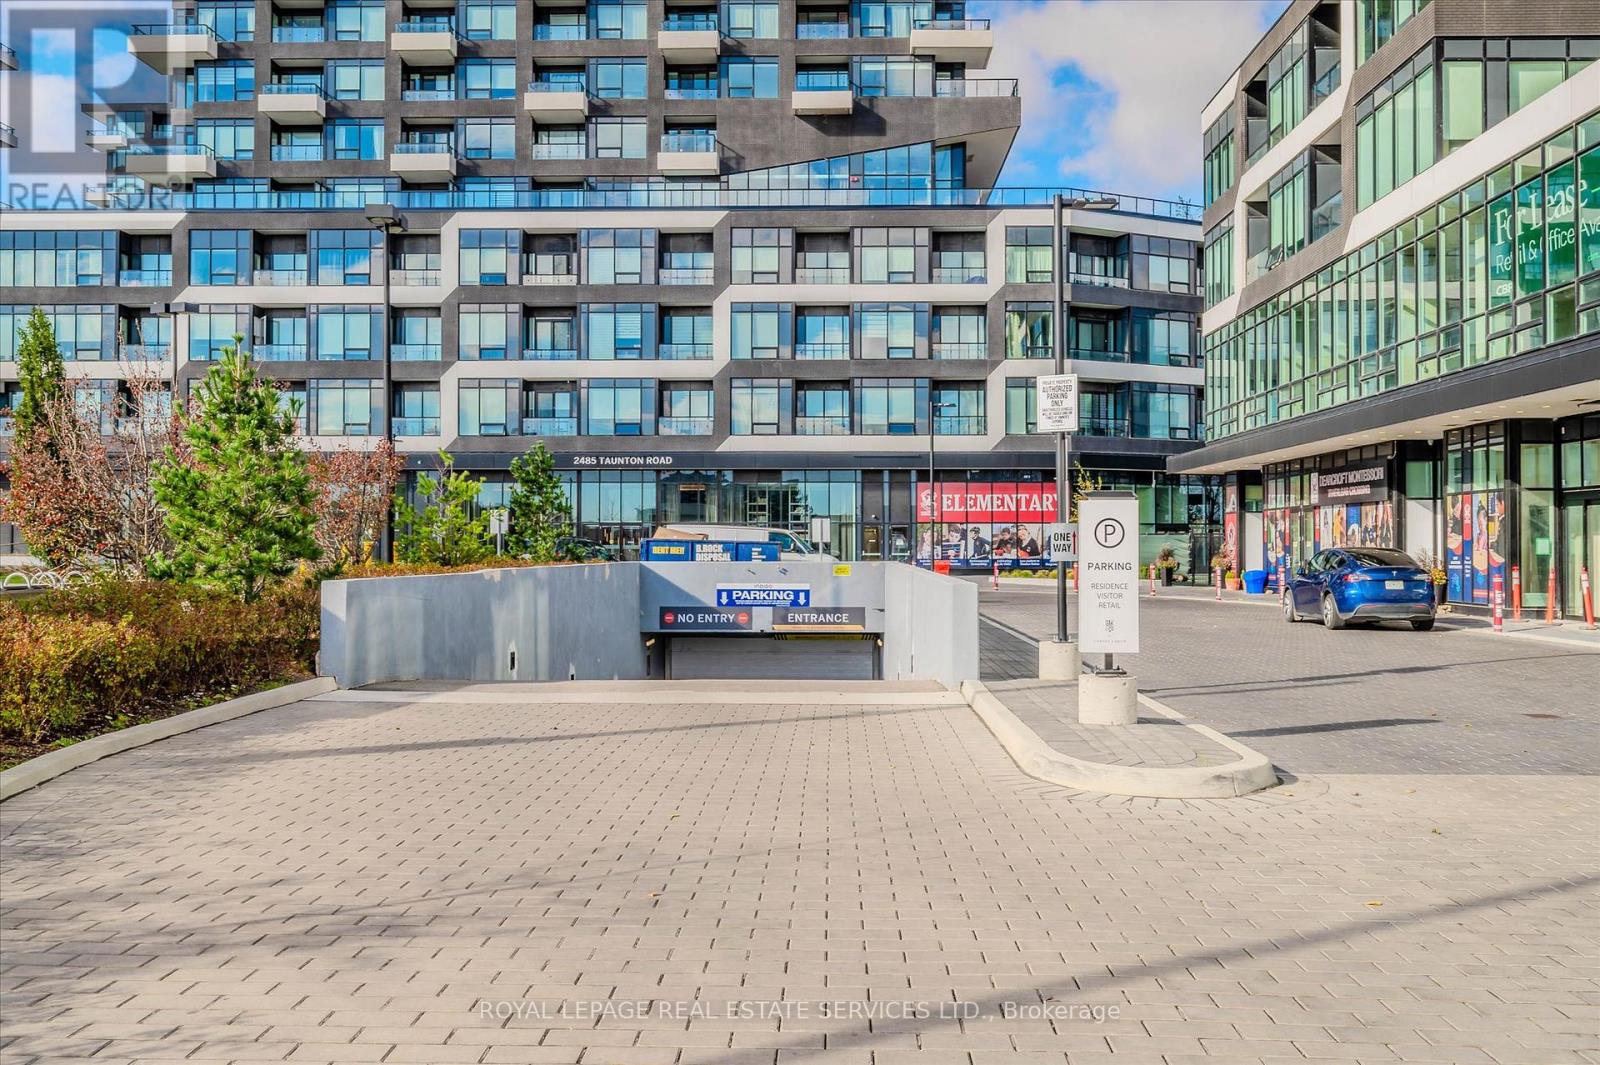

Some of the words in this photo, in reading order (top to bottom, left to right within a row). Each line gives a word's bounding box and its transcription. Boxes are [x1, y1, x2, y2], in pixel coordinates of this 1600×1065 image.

[1528, 179, 1588, 231] Lease
[1496, 243, 1526, 274] Reil
[1528, 240, 1538, 261] &
[1540, 227, 1575, 253] ffice
[1047, 392, 1068, 400] PARKING
[573, 456, 597, 465] 2485
[599, 456, 644, 465] TAUNTON
[646, 456, 673, 465] ROAD
[1053, 532, 1071, 542] ONE
[1104, 524, 1116, 543] P
[1053, 543, 1072, 553] WAY
[1087, 562, 1132, 571] PARKING
[732, 590, 794, 600] PARKING
[1097, 592, 1124, 600] VISITOR
[677, 613, 694, 623] NO
[698, 613, 735, 623] ENTRY
[787, 613, 849, 623] ENTRANCE
